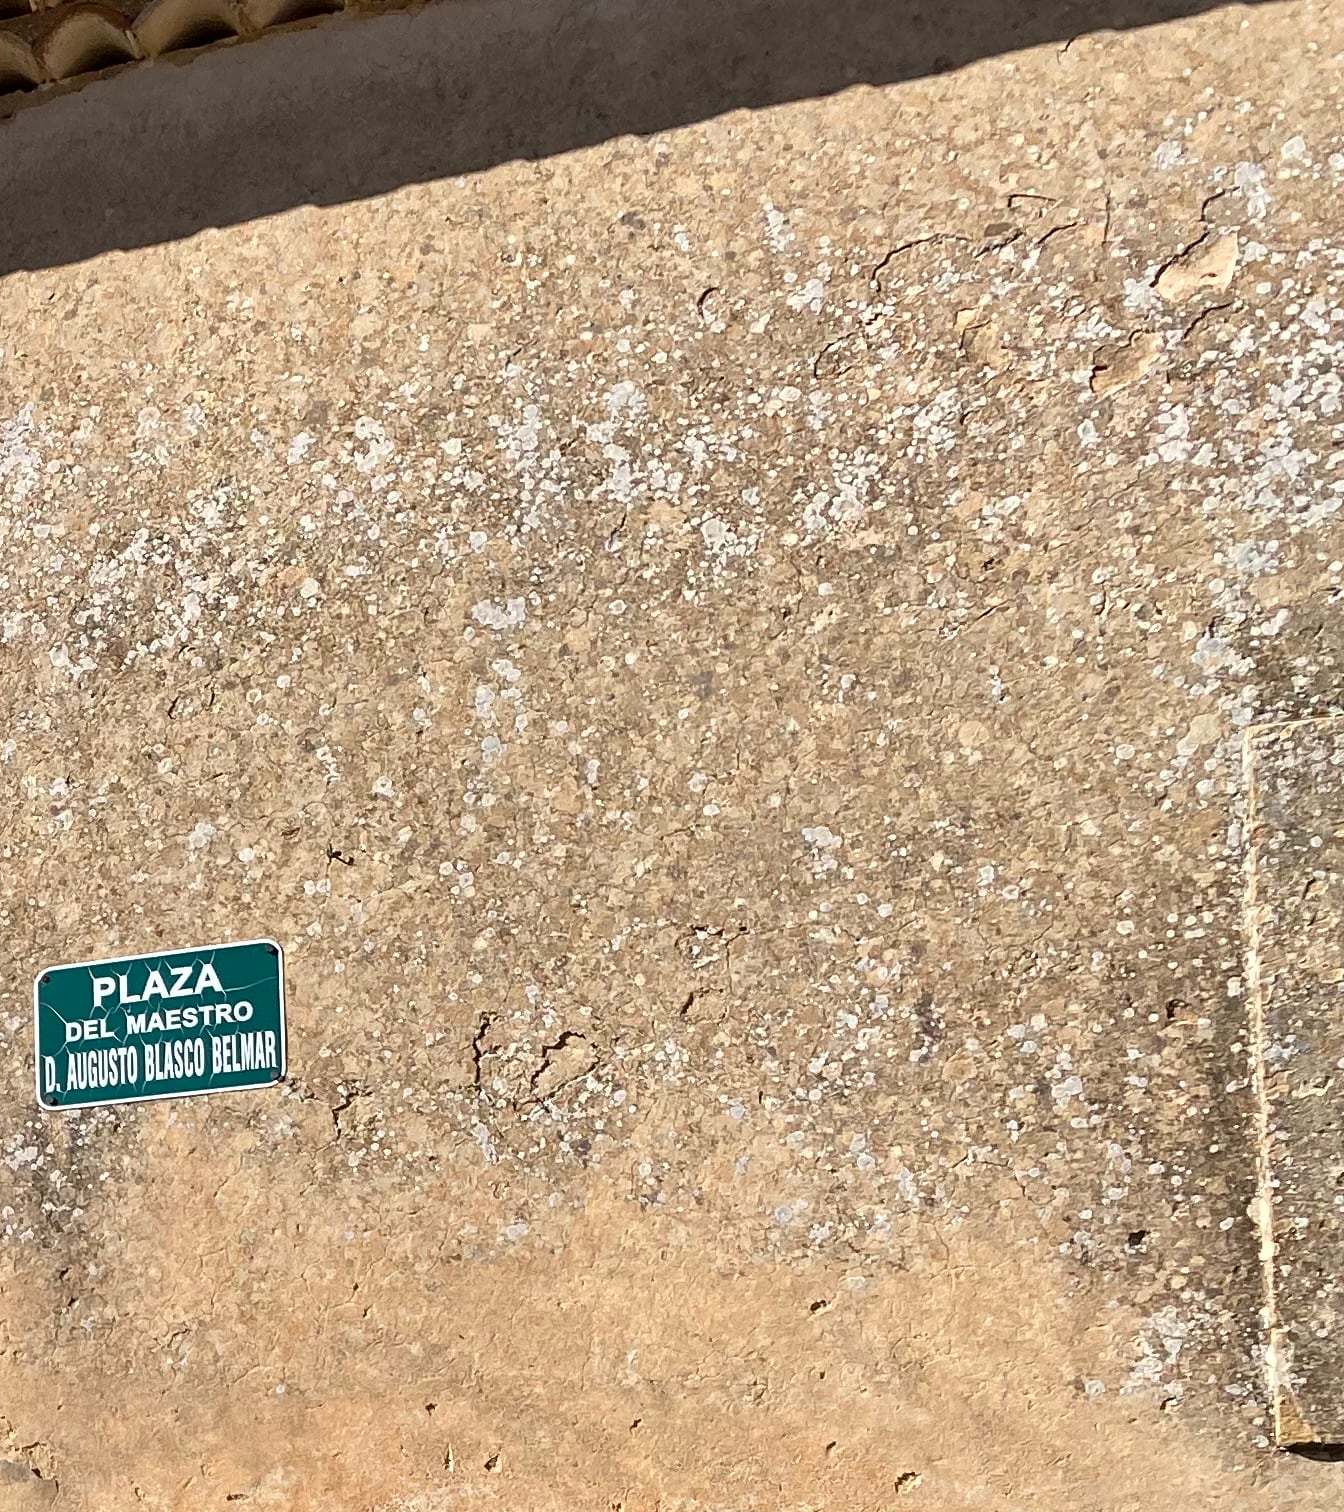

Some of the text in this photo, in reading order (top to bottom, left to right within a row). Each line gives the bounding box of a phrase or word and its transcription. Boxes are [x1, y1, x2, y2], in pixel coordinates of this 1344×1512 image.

[93, 963, 224, 1007] PLAZA
[65, 1001, 254, 1042] DEL MAESTRO
[45, 1030, 278, 1093] D. AUGUSTO BLASCO BELMAR
